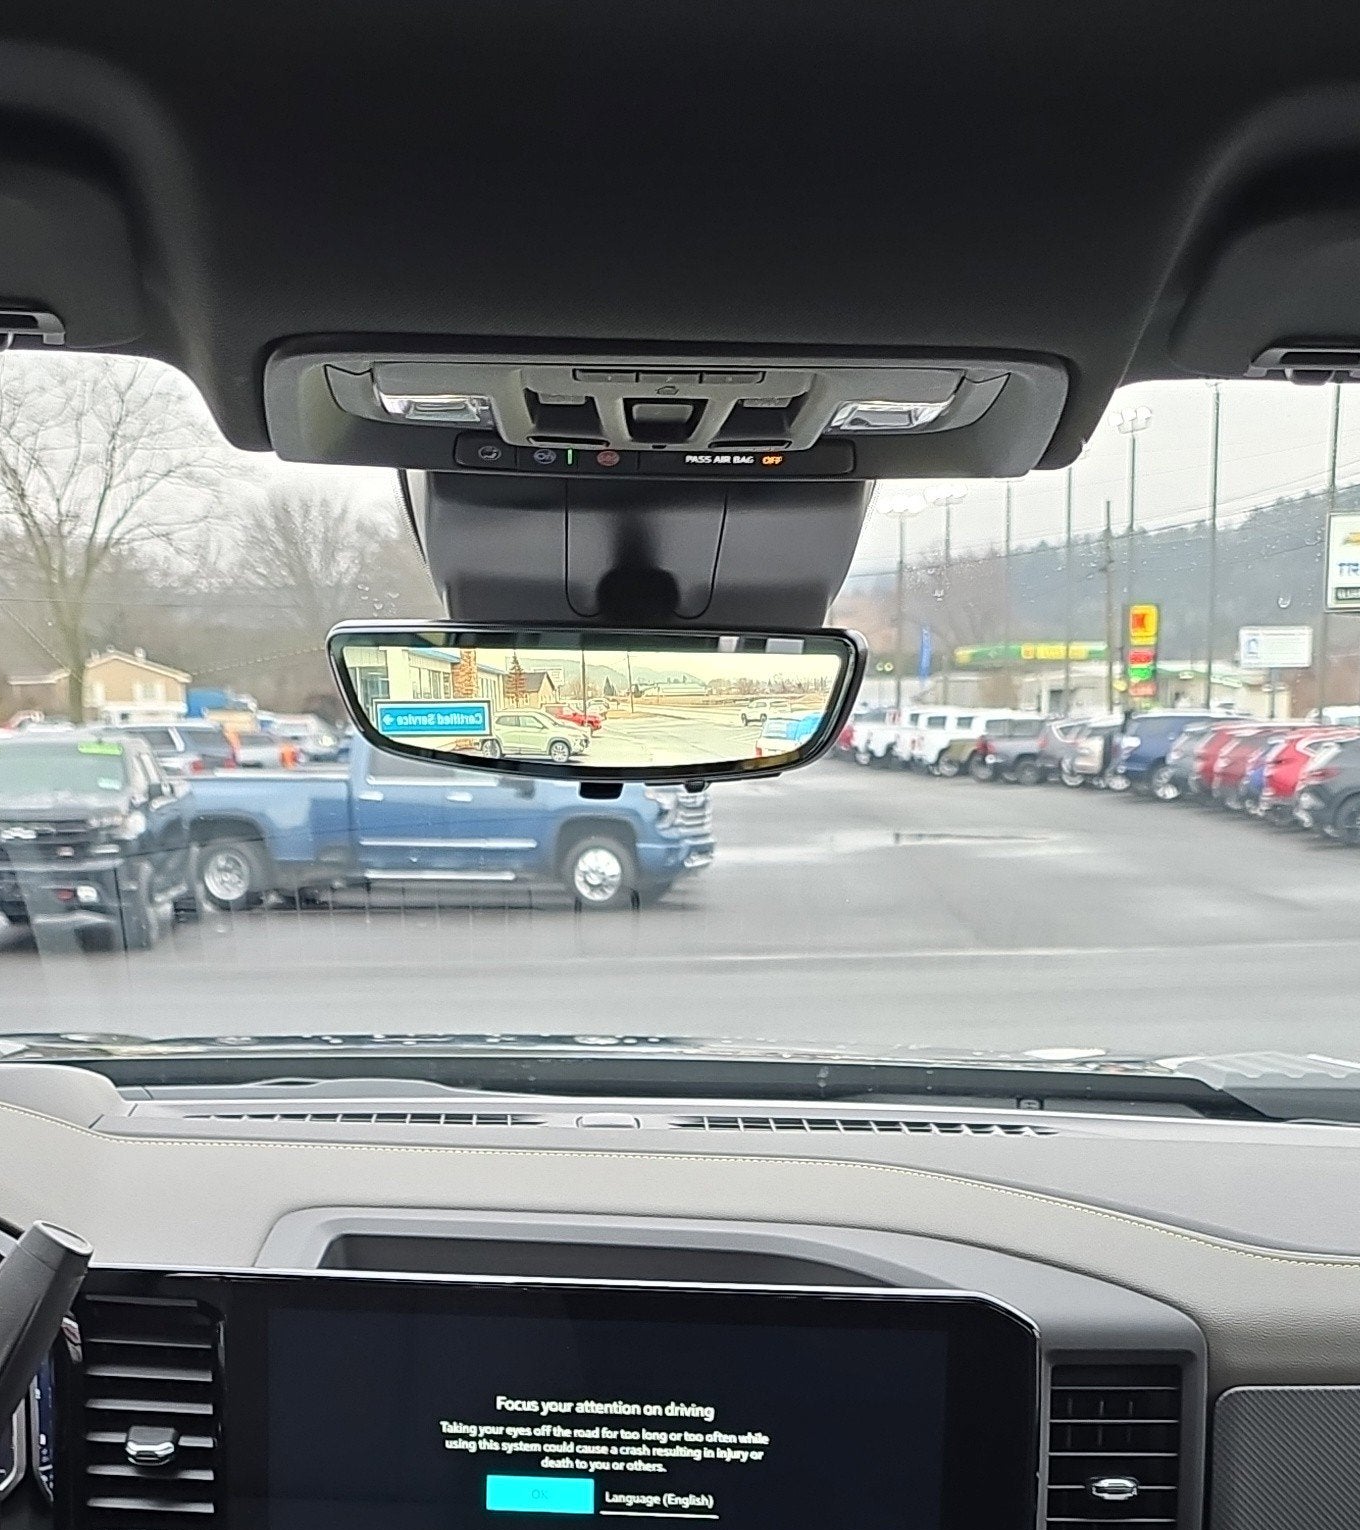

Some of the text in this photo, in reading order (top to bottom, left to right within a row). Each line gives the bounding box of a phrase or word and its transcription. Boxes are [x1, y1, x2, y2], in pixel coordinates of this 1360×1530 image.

[685, 455, 712, 463] PASS
[732, 456, 754, 464] BAG
[762, 456, 783, 465] OFF
[496, 1395, 715, 1422] Focus your attention on driving
[440, 1421, 770, 1444] Taking your eyes off the road for too long or too often while
[445, 1438, 764, 1462] using this system could cause a crash resulting in injury or
[541, 1456, 667, 1472] death to you or others.
[531, 1488, 549, 1500] OK
[605, 1491, 714, 1509] Language (English)
